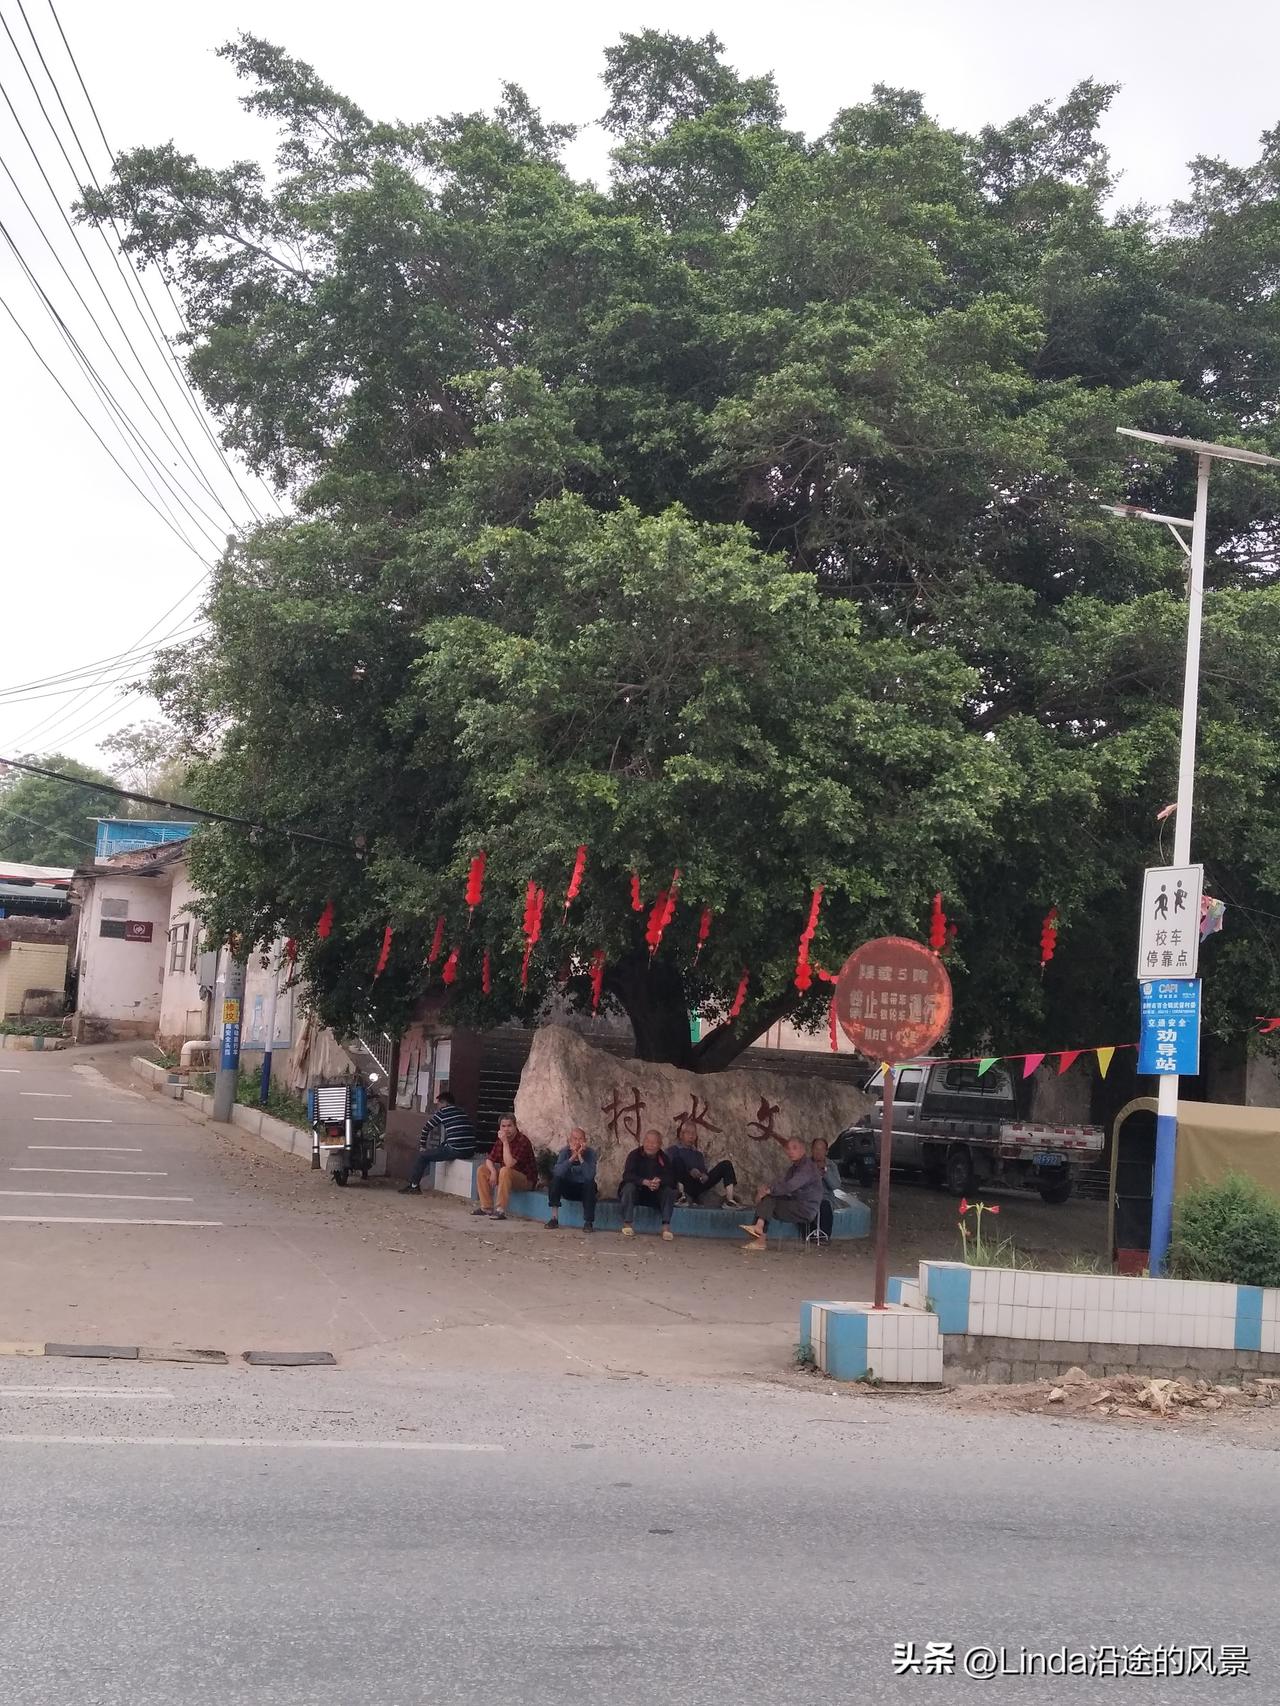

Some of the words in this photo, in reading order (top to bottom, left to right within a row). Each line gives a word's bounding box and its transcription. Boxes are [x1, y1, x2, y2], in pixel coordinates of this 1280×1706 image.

[1155, 928, 1183, 947] 校车
[1146, 949, 1188, 968] 停靠点
[849, 989, 878, 1020] 禁止
[909, 993, 937, 1025] 通行
[1147, 1018, 1187, 1028] 交通安全
[1155, 1028, 1178, 1071] 劝导站
